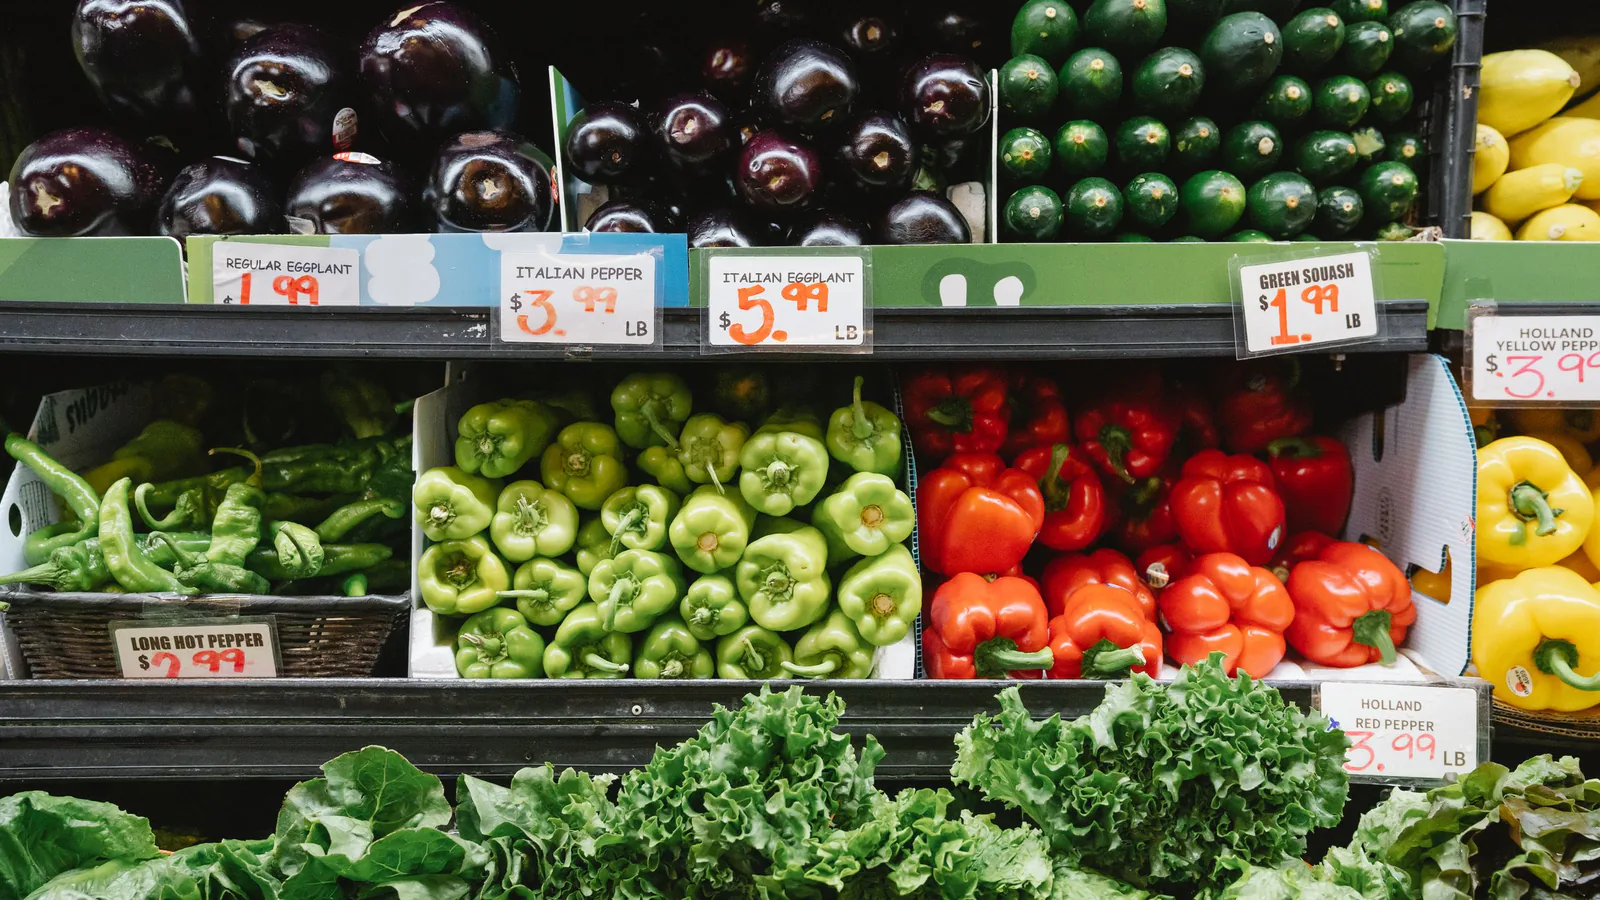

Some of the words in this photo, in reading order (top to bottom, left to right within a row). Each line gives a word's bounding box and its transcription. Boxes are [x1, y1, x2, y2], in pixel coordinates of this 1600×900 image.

[226, 257, 282, 272] REGULAR
[287, 261, 352, 275] EGGPLANT
[516, 266, 585, 280] ITALIAN
[590, 267, 643, 281] PEPPER
[722, 273, 782, 283] ITALIAN
[787, 273, 855, 284] EGGPLANT
[1259, 270, 1300, 290] GREEN
[1303, 263, 1354, 284] SQUASH
[1346, 313, 1361, 329] LB
[625, 321, 648, 337] LB
[835, 325, 858, 340] LB
[1520, 328, 1593, 339] HOLLAND
[1496, 341, 1556, 351] YELLOW
[1562, 341, 1600, 351] PEPP
[131, 636, 171, 651] LONG
[174, 634, 204, 649] HOT
[208, 633, 263, 648] PEPPER
[1362, 699, 1422, 712] HOLLAND
[1356, 718, 1380, 729] RED
[1385, 719, 1434, 731] PEPPER
[1444, 751, 1465, 766] LB
